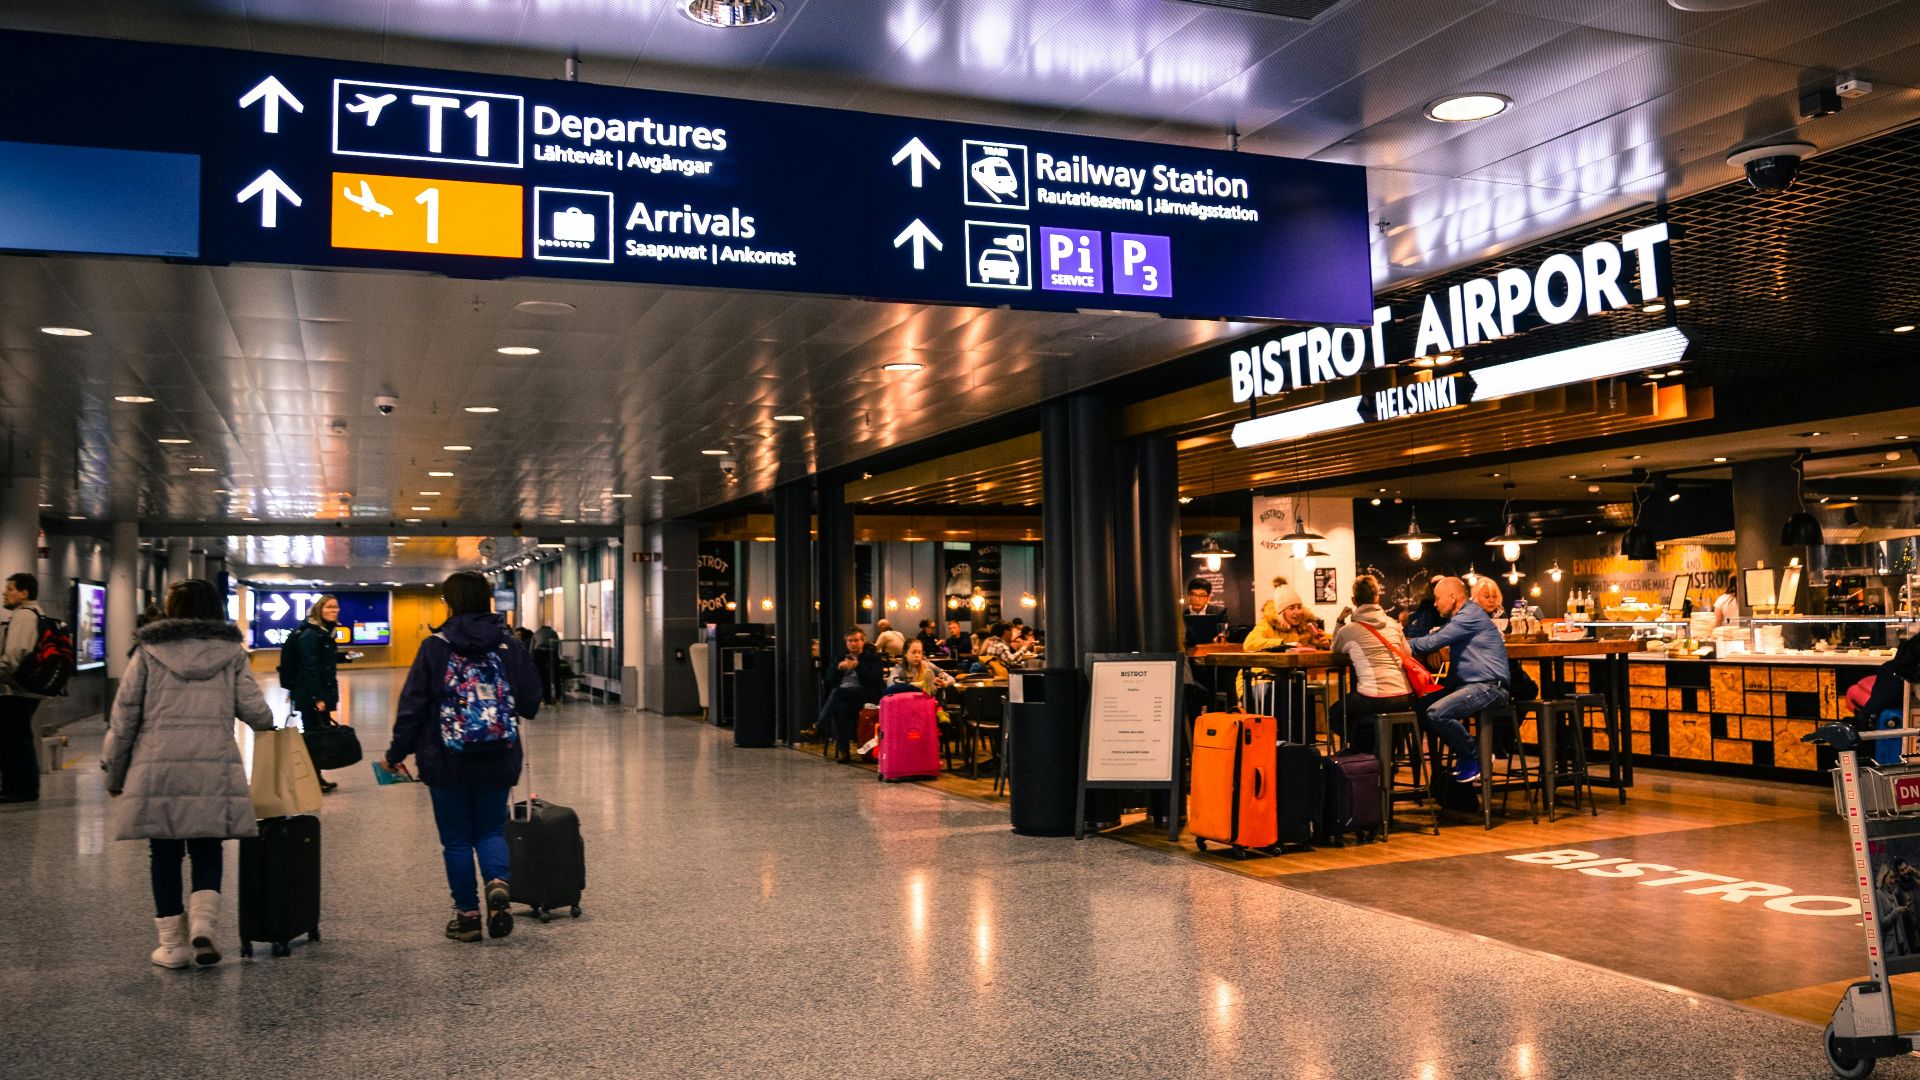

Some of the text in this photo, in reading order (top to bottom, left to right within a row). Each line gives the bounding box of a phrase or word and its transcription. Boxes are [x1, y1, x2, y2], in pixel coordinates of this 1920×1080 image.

[411, 95, 491, 157] T1
[534, 106, 727, 151] Departures
[534, 144, 613, 166] Lähtevät
[627, 151, 713, 176] Avgångar
[1036, 153, 1249, 200] Railway Station
[415, 188, 439, 244] 1
[625, 203, 756, 238] Arrivals
[1037, 188, 1144, 212] Rautatieasema
[1154, 200, 1259, 222] Järnvägsstation
[625, 240, 708, 261] Saapuvat
[720, 245, 797, 266] Ankomst
[1049, 234, 1094, 273] Pi
[1051, 274, 1095, 287] SERVICE
[1231, 222, 1669, 403] BISTROT AIRPORT
[1375, 376, 1458, 421] HELSINKI
[1260, 509, 1286, 523] BISTROT
[697, 555, 729, 573] STROT
[1688, 569, 1730, 589] ISTROT
[698, 592, 727, 612] PORT
[1504, 848, 1864, 926] BISTRO
